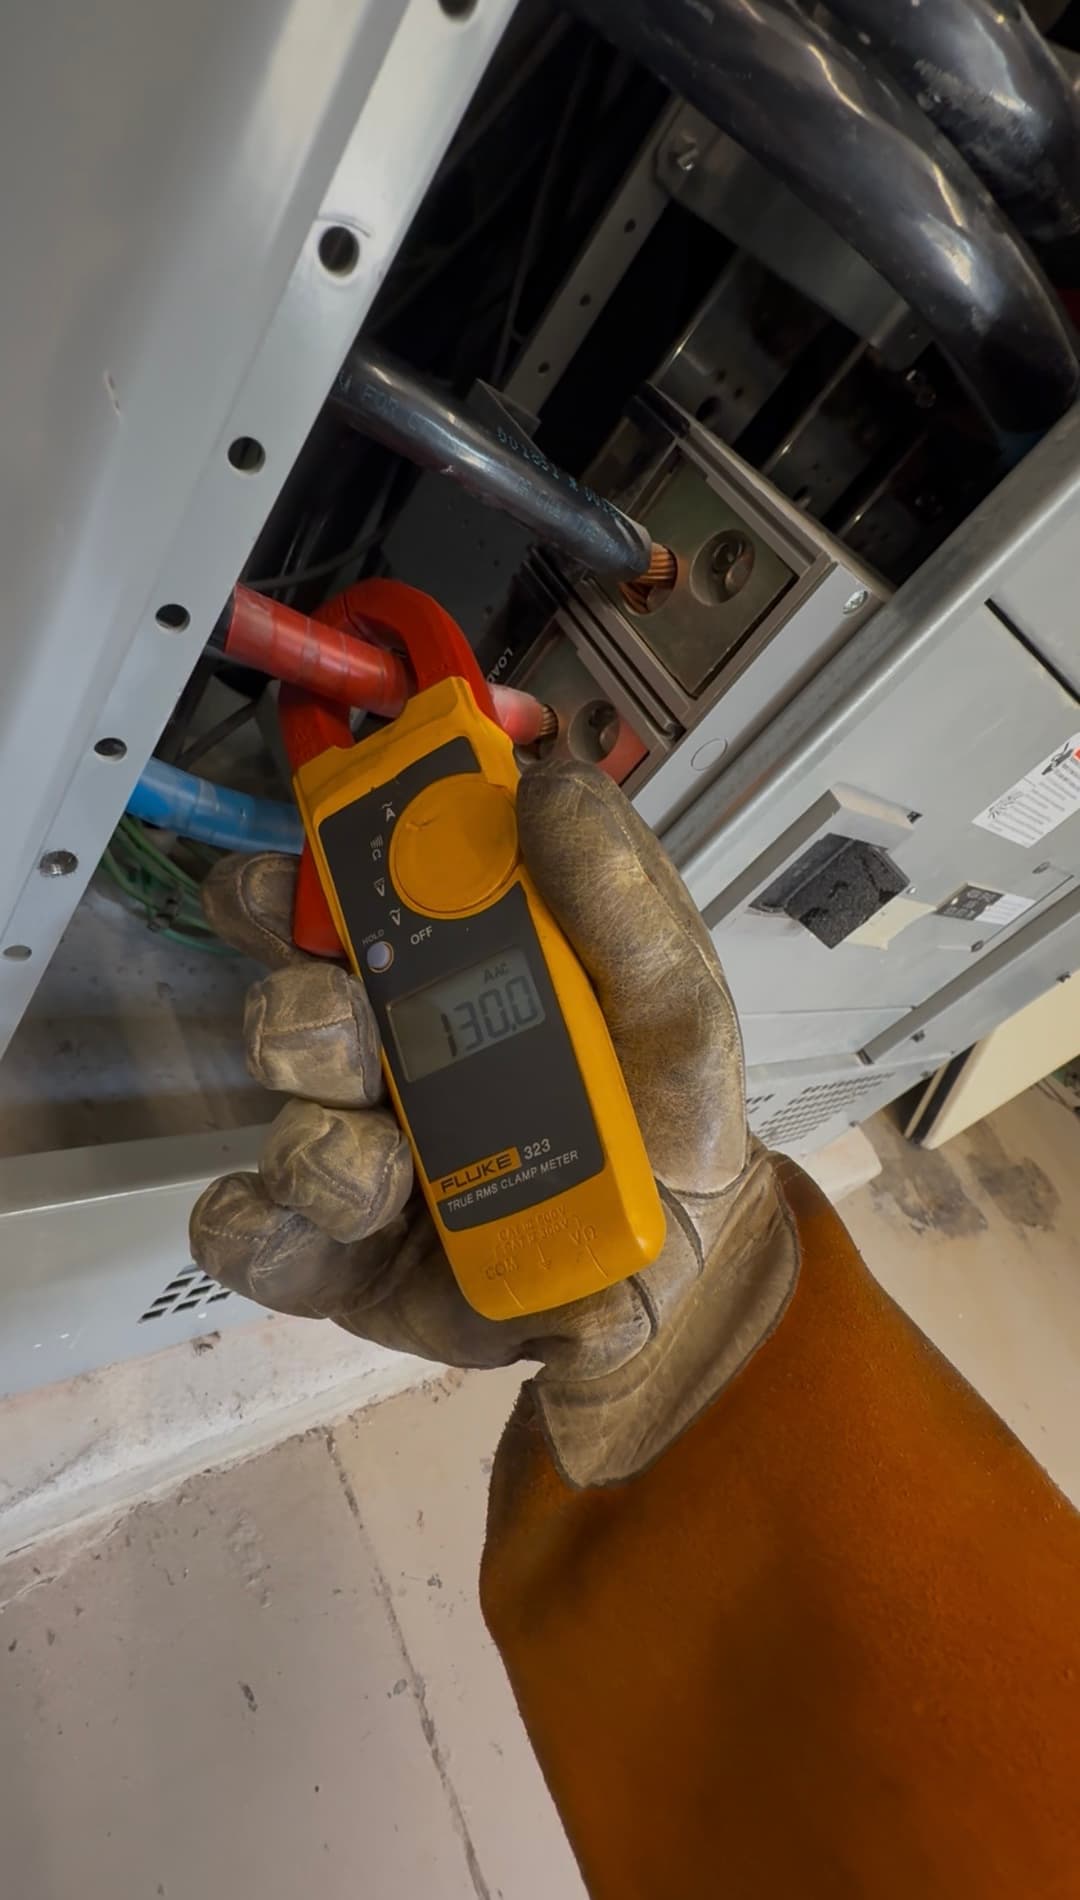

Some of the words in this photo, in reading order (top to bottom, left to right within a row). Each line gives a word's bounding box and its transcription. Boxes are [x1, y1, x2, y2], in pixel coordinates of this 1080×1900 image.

[362, 929, 385, 945] HOLD
[410, 926, 433, 945] OFF
[440, 1153, 513, 1193] FLUKE
[523, 1138, 551, 1160] 323
[447, 1193, 474, 1213] TRUE
[475, 1183, 499, 1201] RMS
[500, 1166, 537, 1190] CLAMP
[540, 1150, 579, 1174] METER
